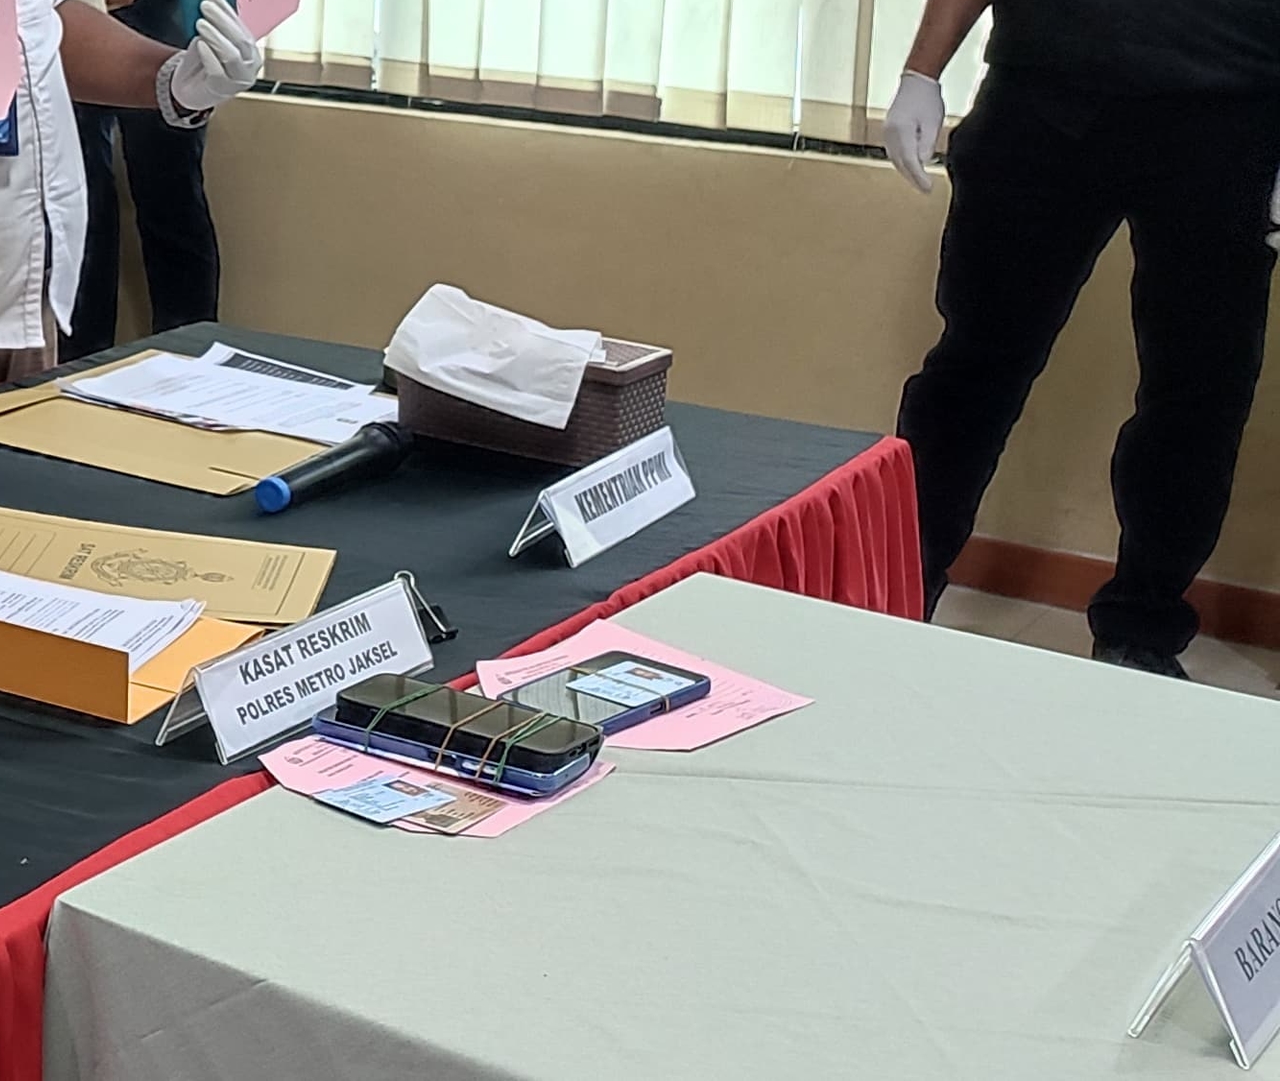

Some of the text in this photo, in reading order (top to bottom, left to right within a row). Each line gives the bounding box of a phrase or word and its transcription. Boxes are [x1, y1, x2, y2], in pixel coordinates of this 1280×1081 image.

[235, 639, 399, 726] POLRES METRO JAKSEL
[238, 611, 373, 686] KASAT RESKRIM
[1233, 898, 1280, 982] BARAN
